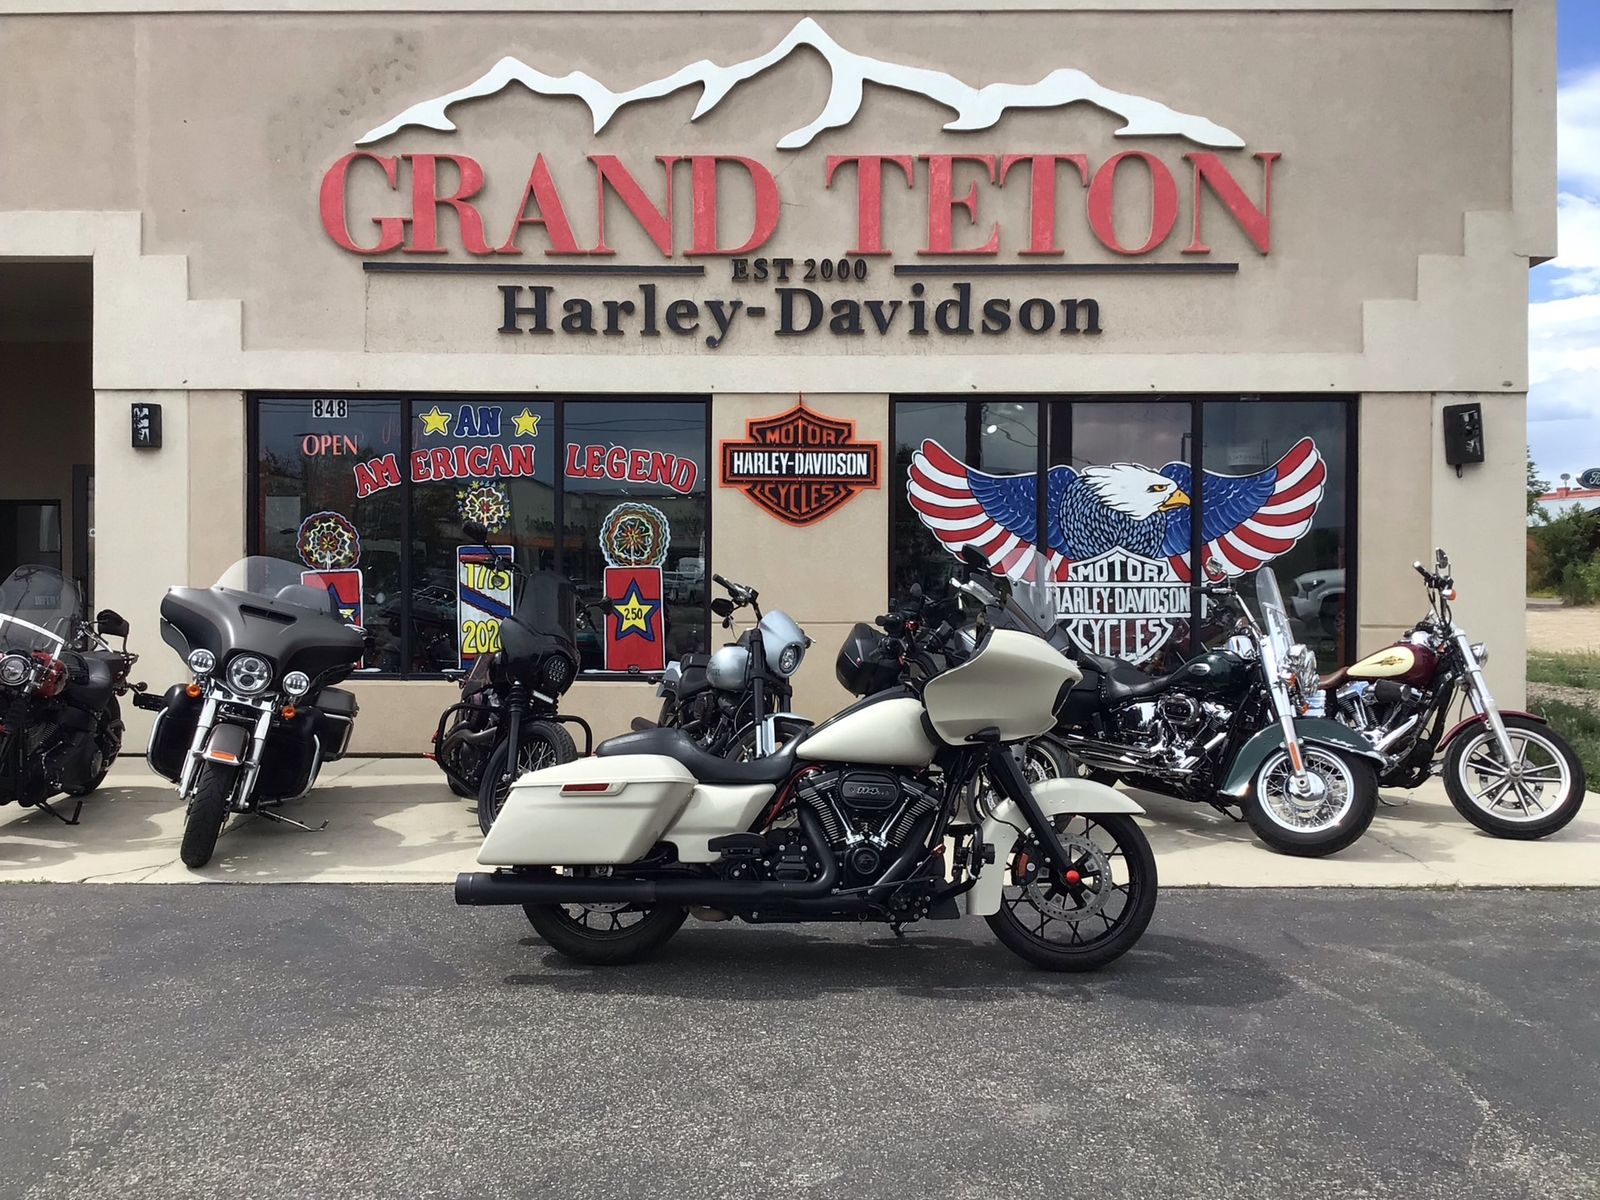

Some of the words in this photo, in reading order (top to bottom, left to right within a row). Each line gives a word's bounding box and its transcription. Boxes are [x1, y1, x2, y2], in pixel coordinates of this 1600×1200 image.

[319, 151, 781, 257] GRAND
[825, 150, 1282, 256] TETON
[731, 258, 794, 280] EST
[803, 258, 868, 280] 2000
[498, 282, 1103, 348] Harley-Davidson
[314, 400, 347, 417] 848
[454, 405, 502, 437] AN
[303, 434, 358, 456] OPEN
[766, 420, 836, 444] MOTOR
[564, 443, 698, 494] LEGEND
[733, 452, 867, 475] HARLEY-DAVIDSON
[764, 483, 835, 514] CYCLES
[1078, 552, 1160, 582] MOTOR
[624, 607, 643, 621] 250
[462, 619, 503, 654] 202
[1077, 618, 1163, 661] CYCLES
